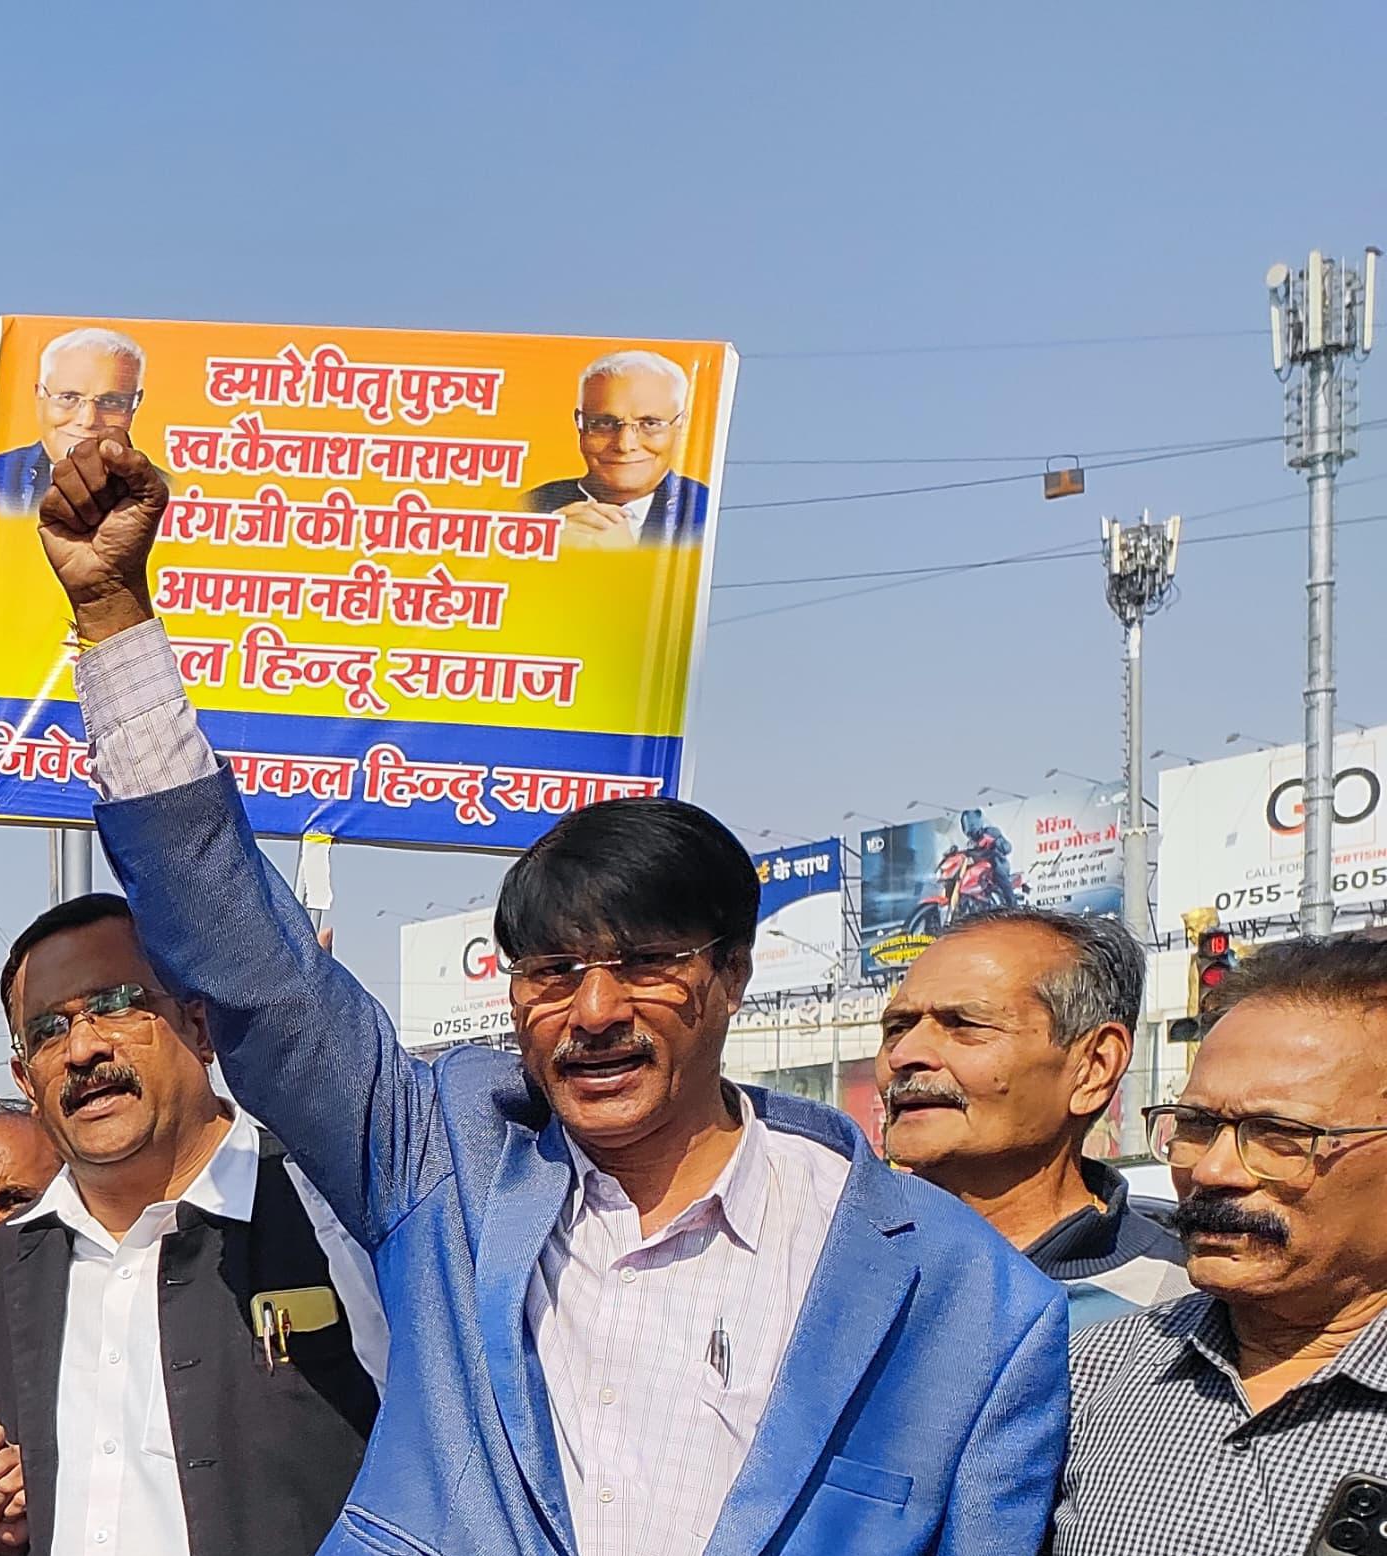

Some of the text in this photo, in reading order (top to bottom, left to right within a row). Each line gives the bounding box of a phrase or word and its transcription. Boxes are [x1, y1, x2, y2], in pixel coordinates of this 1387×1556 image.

[210, 349, 499, 421] हमारे पितृ पुरुष
[371, 441, 522, 483] नारायण
[235, 493, 289, 544] जी
[298, 496, 354, 548] की
[365, 496, 486, 554] प्रतिमा
[500, 516, 559, 556] का
[159, 569, 505, 626] अपमान नहीं सहेगा
[245, 629, 389, 710] हिन्दू
[391, 659, 579, 703] समाज
[367, 746, 490, 824] हिन्दू
[795, 854, 829, 877] साथ
[1246, 865, 1277, 880] CALL
[434, 1012, 509, 1036] 0755-276
[451, 1003, 467, 1013] CALL
[469, 1002, 484, 1010] FOR
